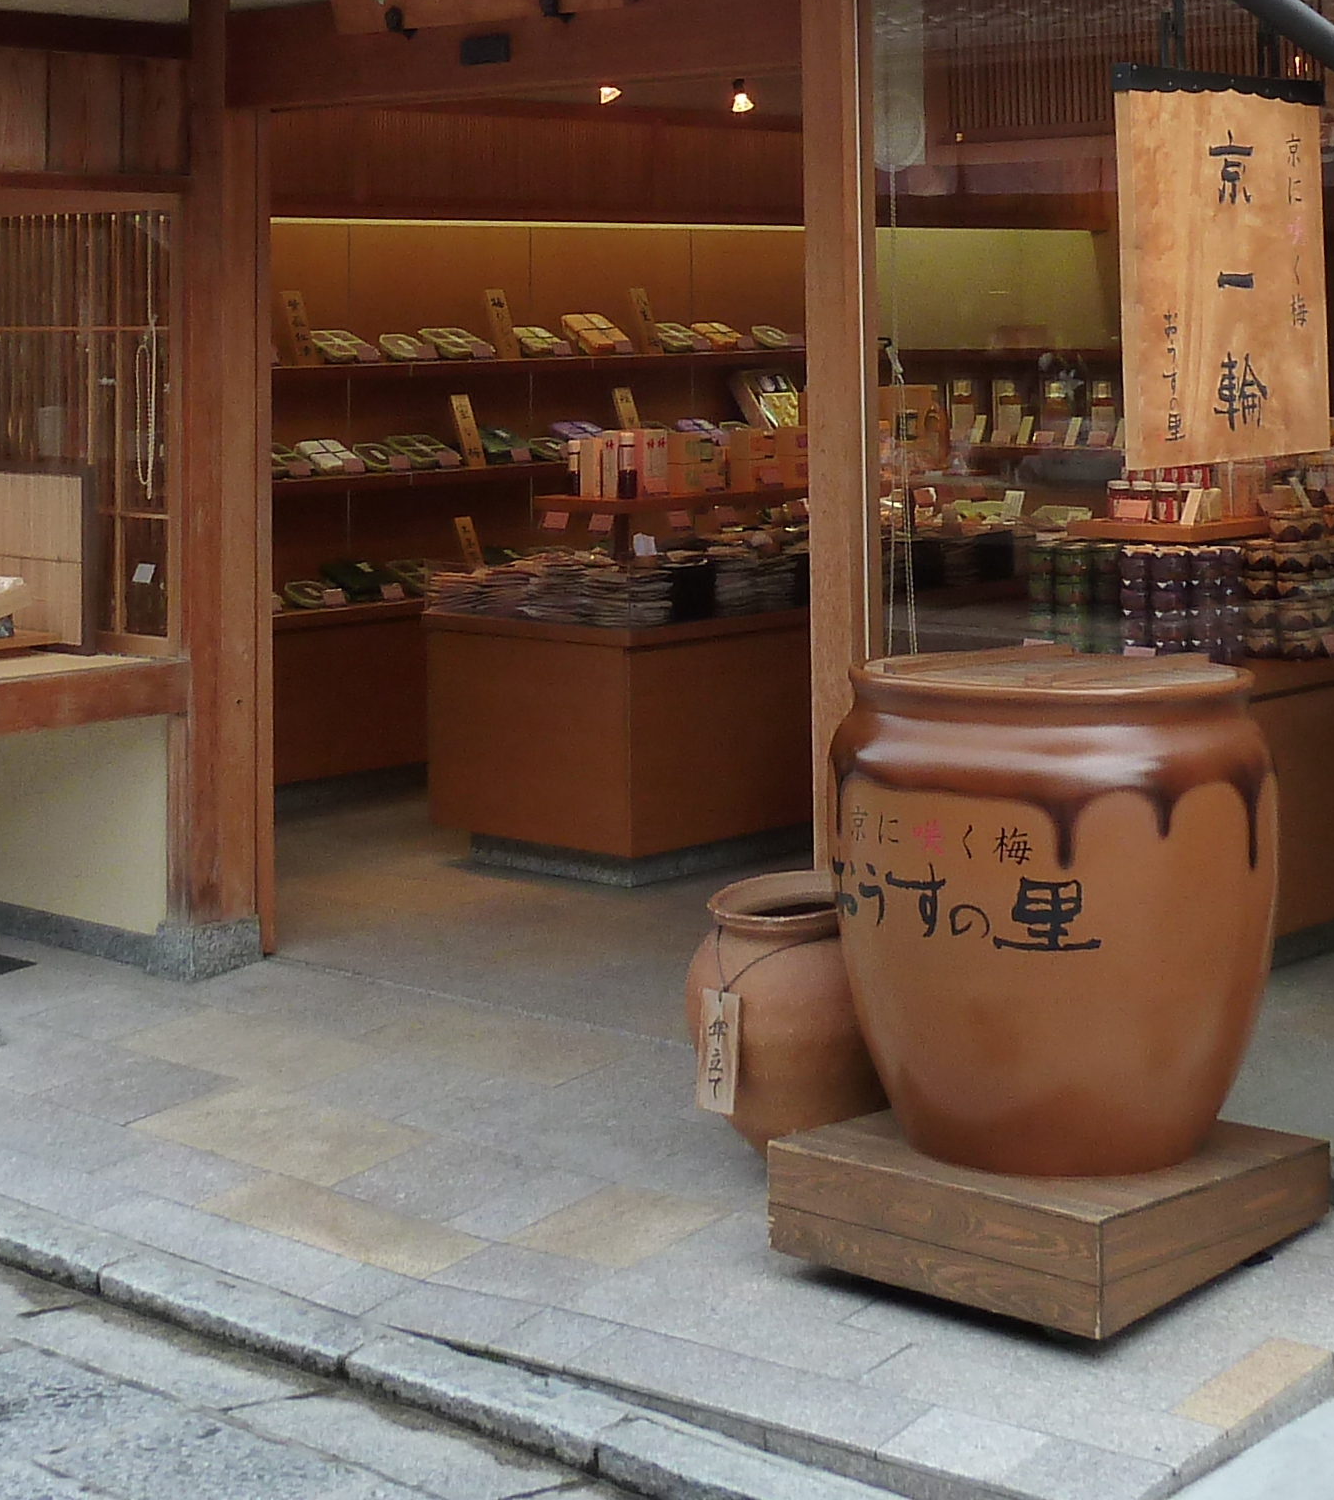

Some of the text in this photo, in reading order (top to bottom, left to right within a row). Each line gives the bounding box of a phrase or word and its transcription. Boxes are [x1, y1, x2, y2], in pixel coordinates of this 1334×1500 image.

[1208, 129, 1267, 431] 京一輪
[1162, 309, 1186, 442] おうすの里
[849, 805, 1033, 866] 京に咲く梅
[832, 847, 1102, 952] おうすの里
[708, 1016, 729, 1099] 傘立て
